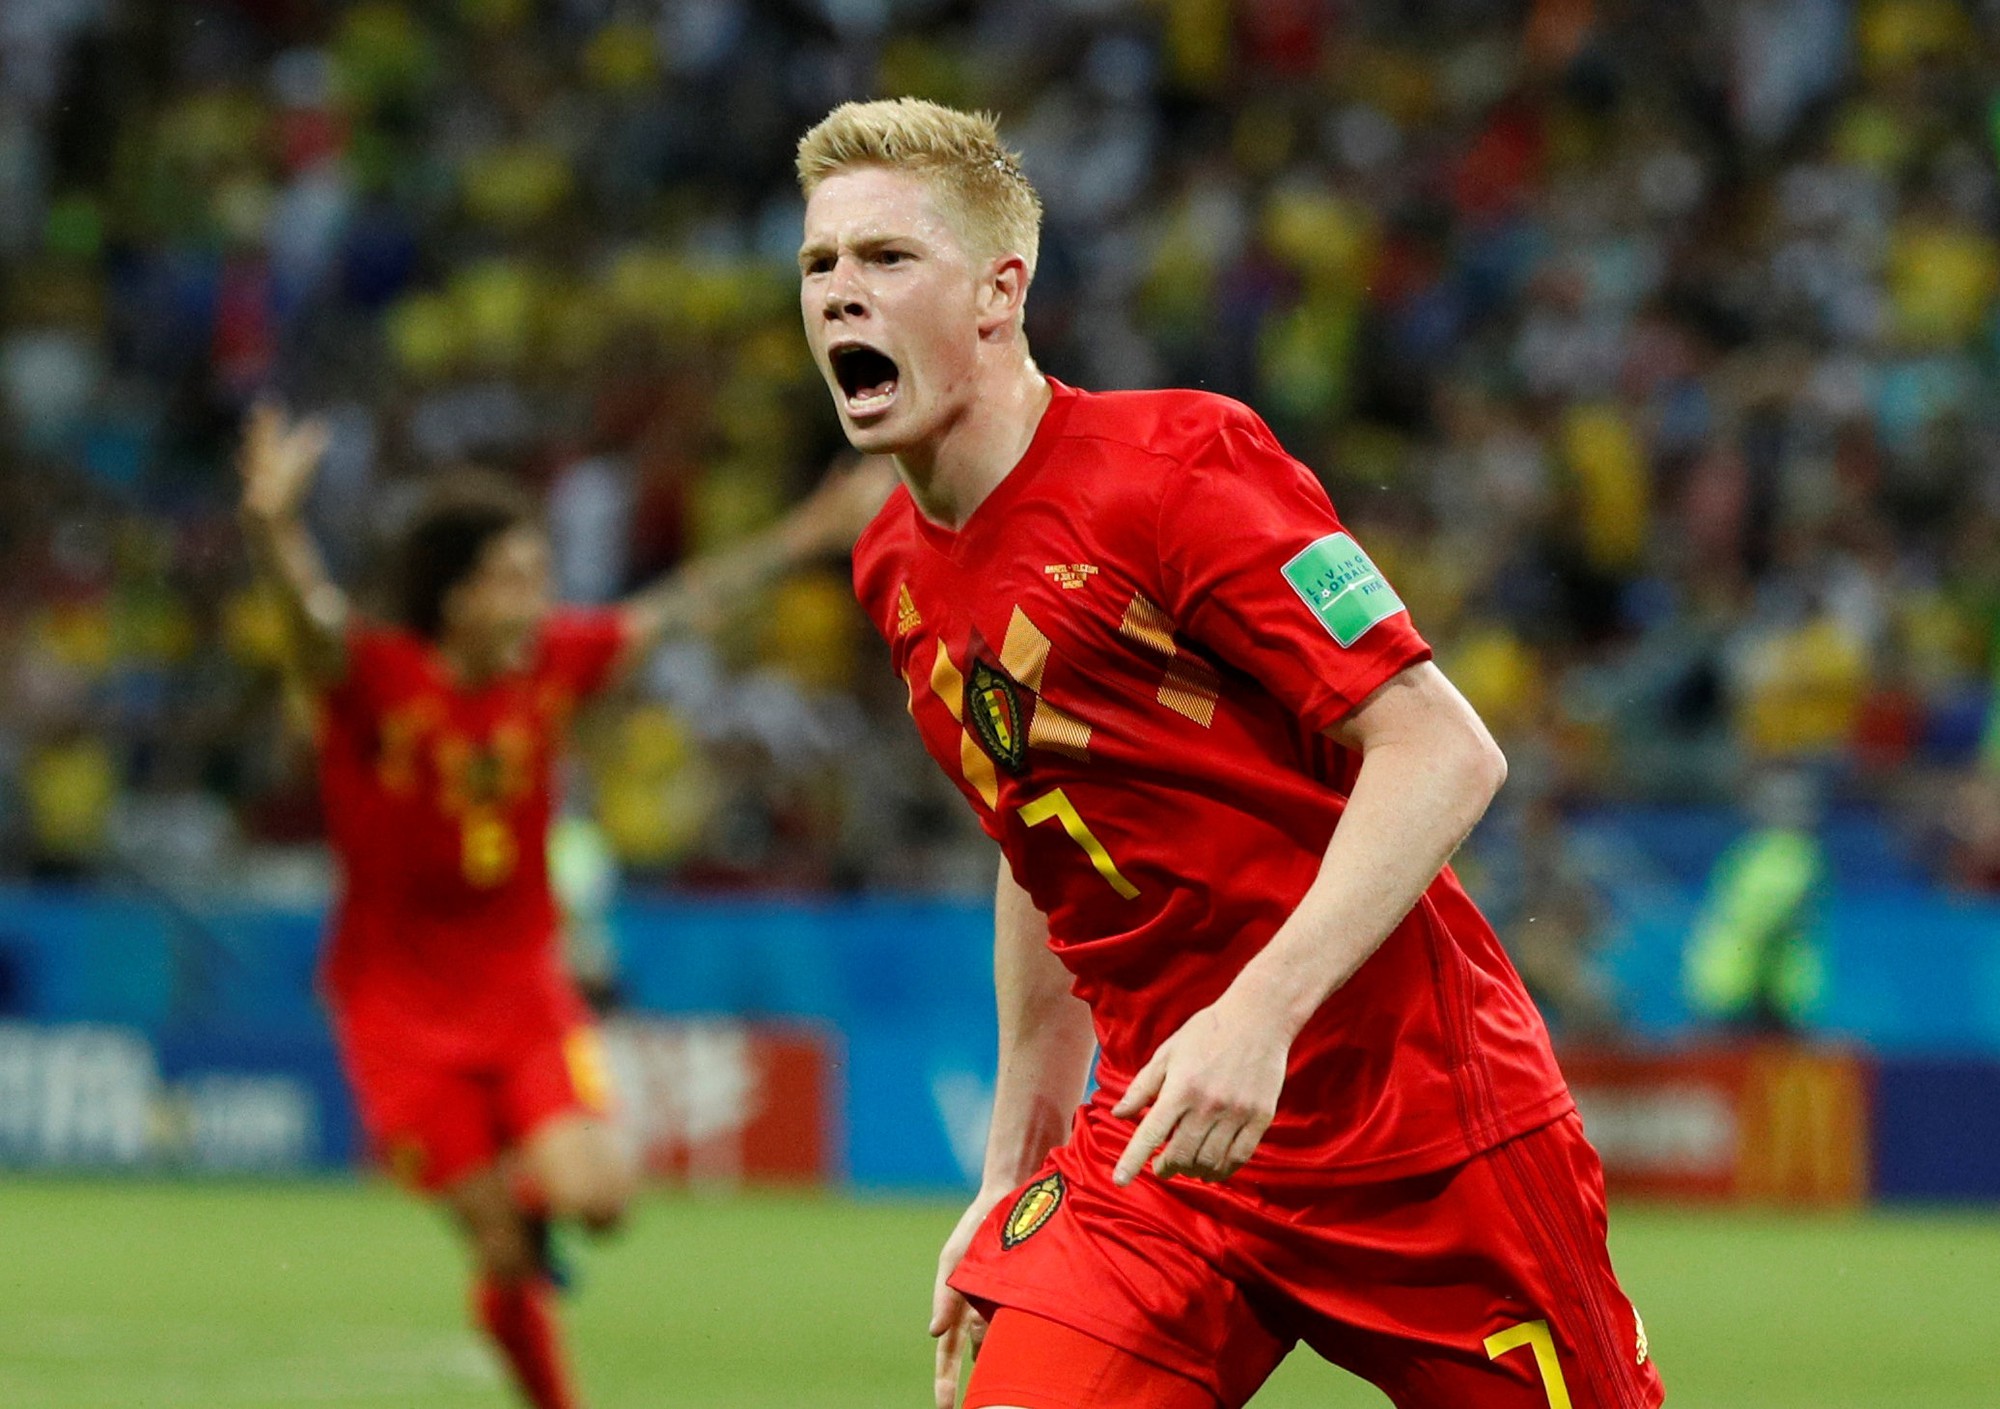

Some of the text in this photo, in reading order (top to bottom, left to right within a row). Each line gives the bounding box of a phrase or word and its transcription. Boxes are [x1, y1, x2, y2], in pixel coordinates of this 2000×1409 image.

[1306, 555, 1362, 596] LIVING
[1362, 581, 1382, 595] FIFA
[1016, 787, 1141, 901] 7
[1483, 1319, 1572, 1409] 7
